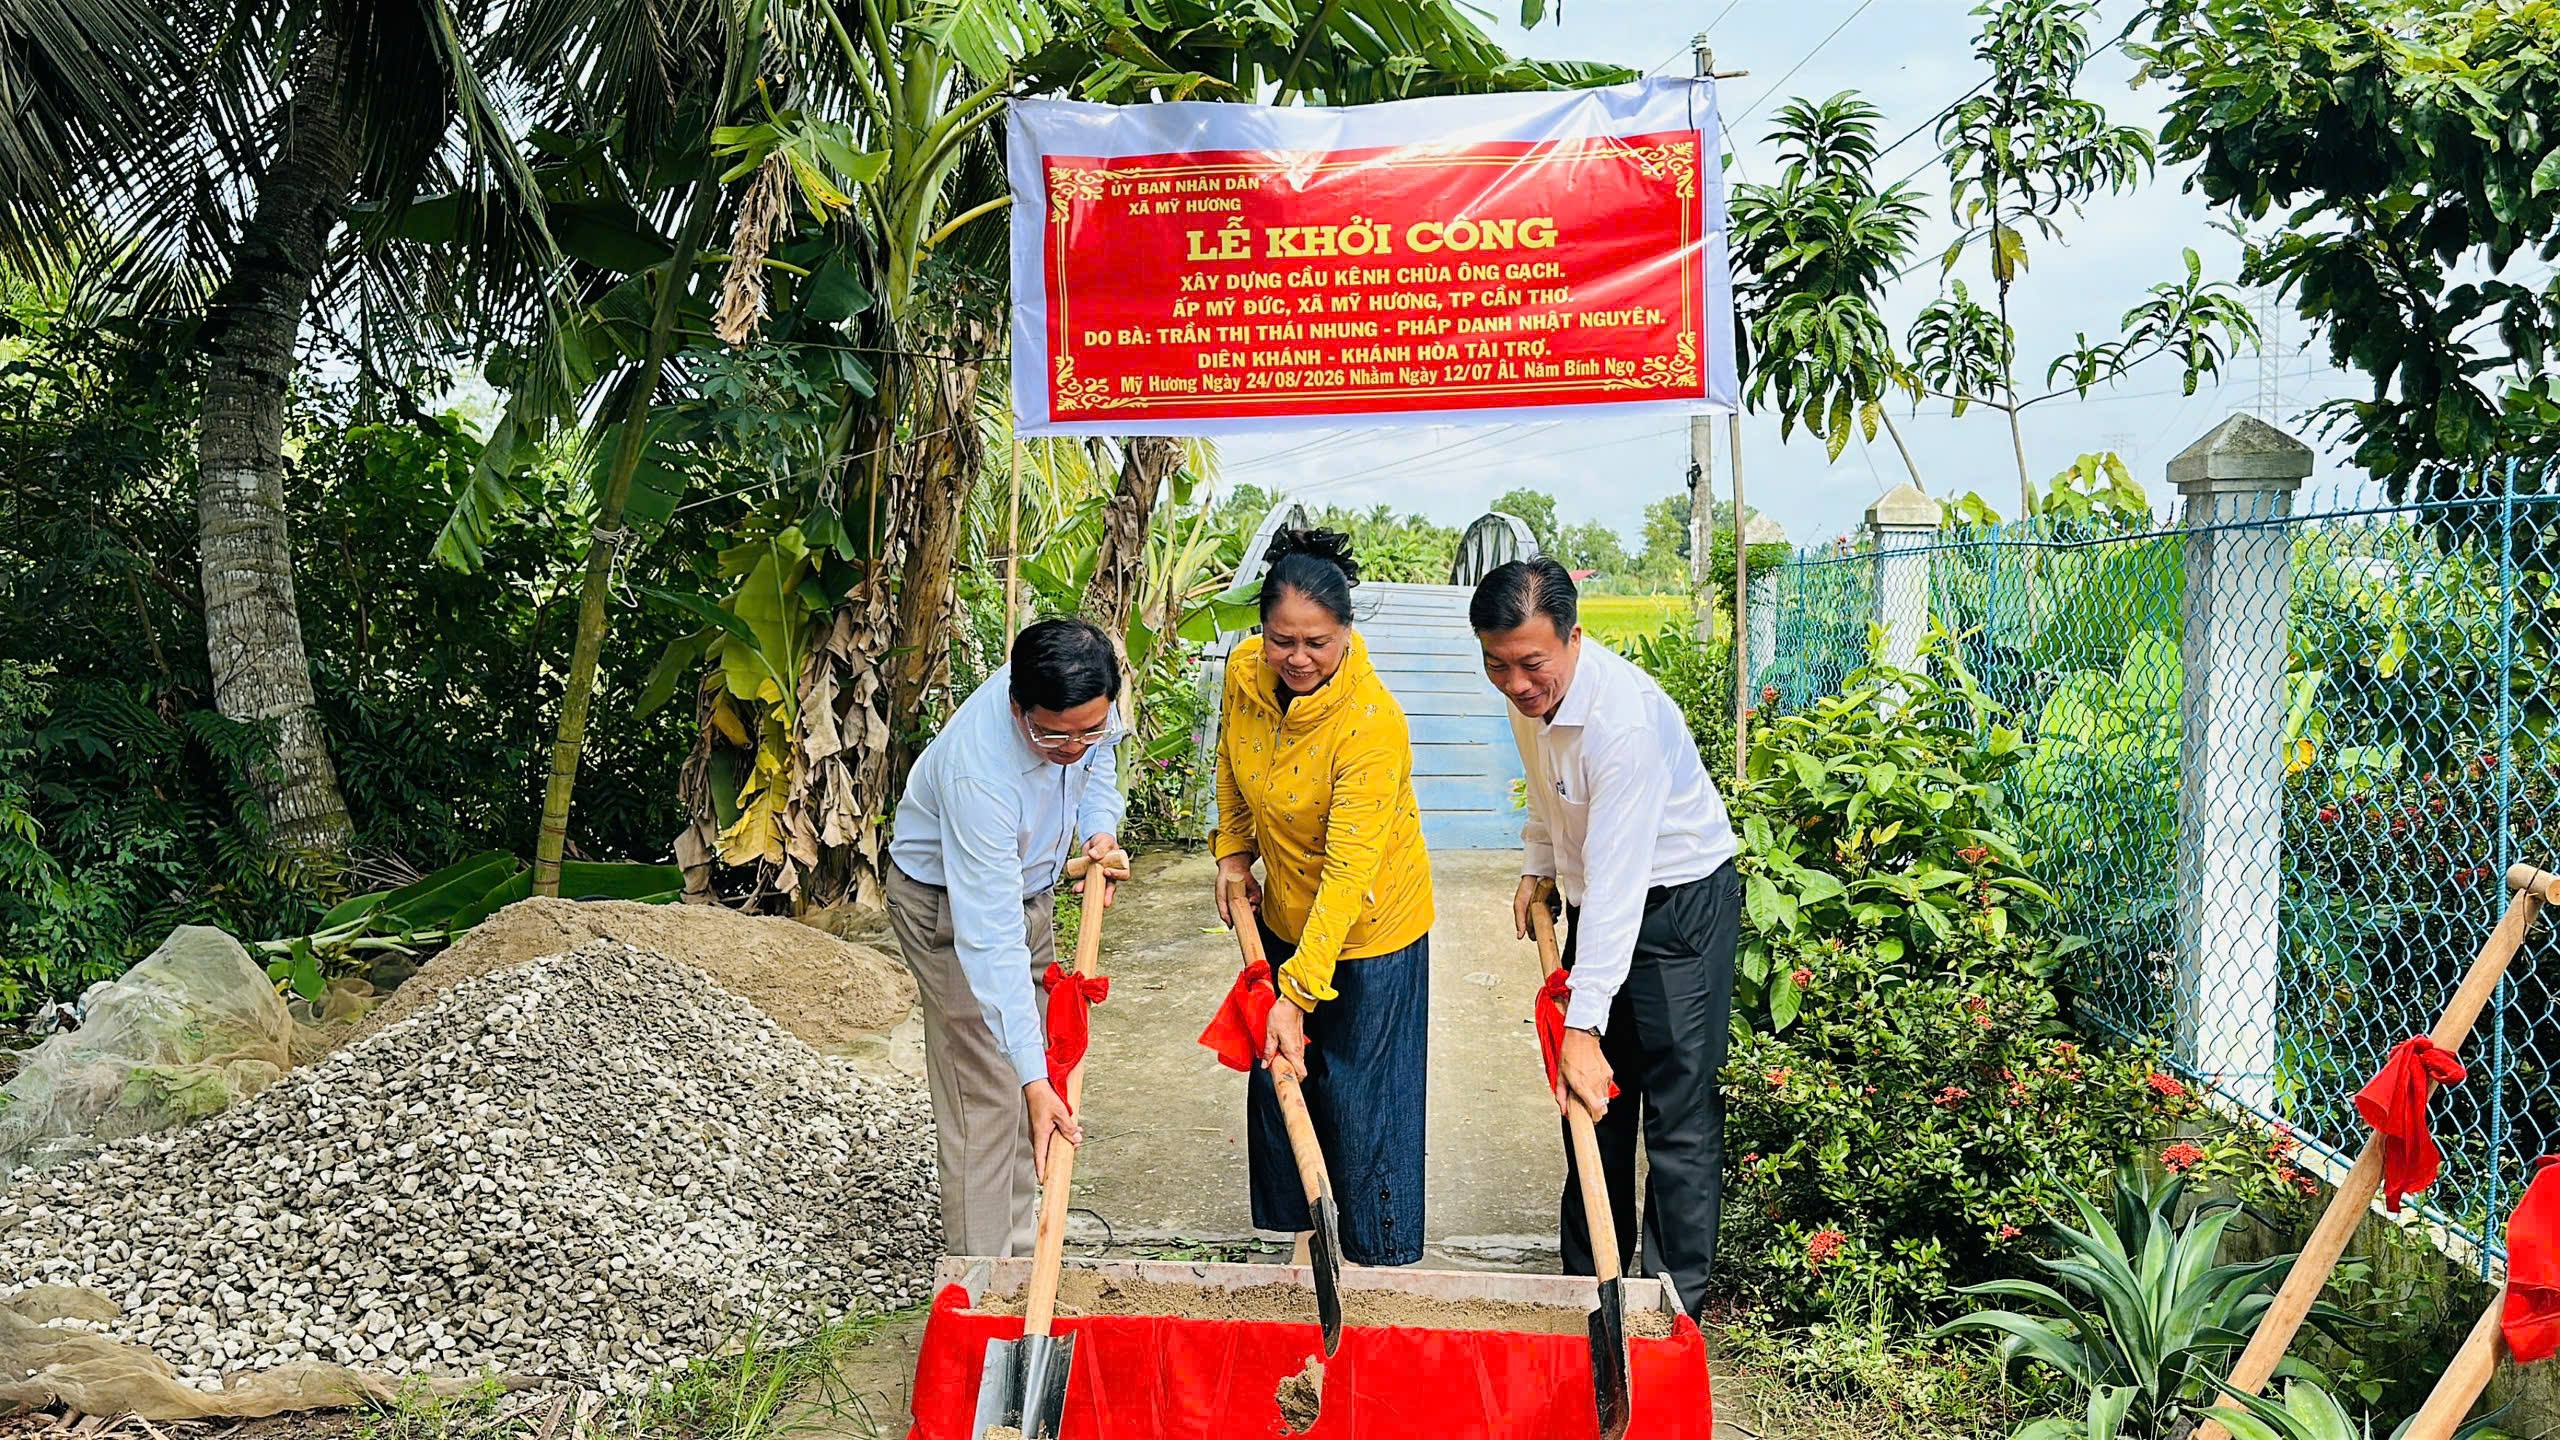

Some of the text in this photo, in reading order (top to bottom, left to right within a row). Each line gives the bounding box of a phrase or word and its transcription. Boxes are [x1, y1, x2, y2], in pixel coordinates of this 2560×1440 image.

[1111, 175, 1260, 197] ỦY BAN NHÂN DÂN
[1128, 198, 1241, 215] XÃ MỸ HƯƠNG
[1186, 213, 1558, 261] LỄ KHỞI CÔNG
[1180, 261, 1566, 292] XÂY DỰNG CẦU KÊNH CHÙA ÔNG GẠCH.
[1172, 284, 1574, 318] ẤP MỸ ĐỨC, XÃ MỸ HƯƠNG, TP CẦN THƠ.
[1084, 330, 1112, 347] DO
[1117, 325, 1151, 345] BÀ:
[1156, 321, 1211, 344] TRẦN
[1216, 325, 1250, 344] THỊ
[1255, 320, 1303, 341] THÁI
[1309, 320, 1378, 340] NHUNG
[1397, 314, 1452, 336] PHÁP
[1457, 316, 1512, 334] DANH
[1519, 311, 1573, 332] NHẬT
[1579, 307, 1666, 328] NGUYÊN.
[1198, 349, 1246, 369] DIÊN
[1252, 346, 1321, 368] KHÁNH
[1341, 340, 1411, 364] KHÁNH
[1417, 338, 1459, 362] HÒA
[1464, 337, 1500, 359] TÀI
[1504, 337, 1552, 359] TRỢ.
[1120, 356, 1636, 395] Mỹ Hương Ngày 24/08/2026 Nhằm Ngày 12/07 ÂL Năm Bính Ngọ
